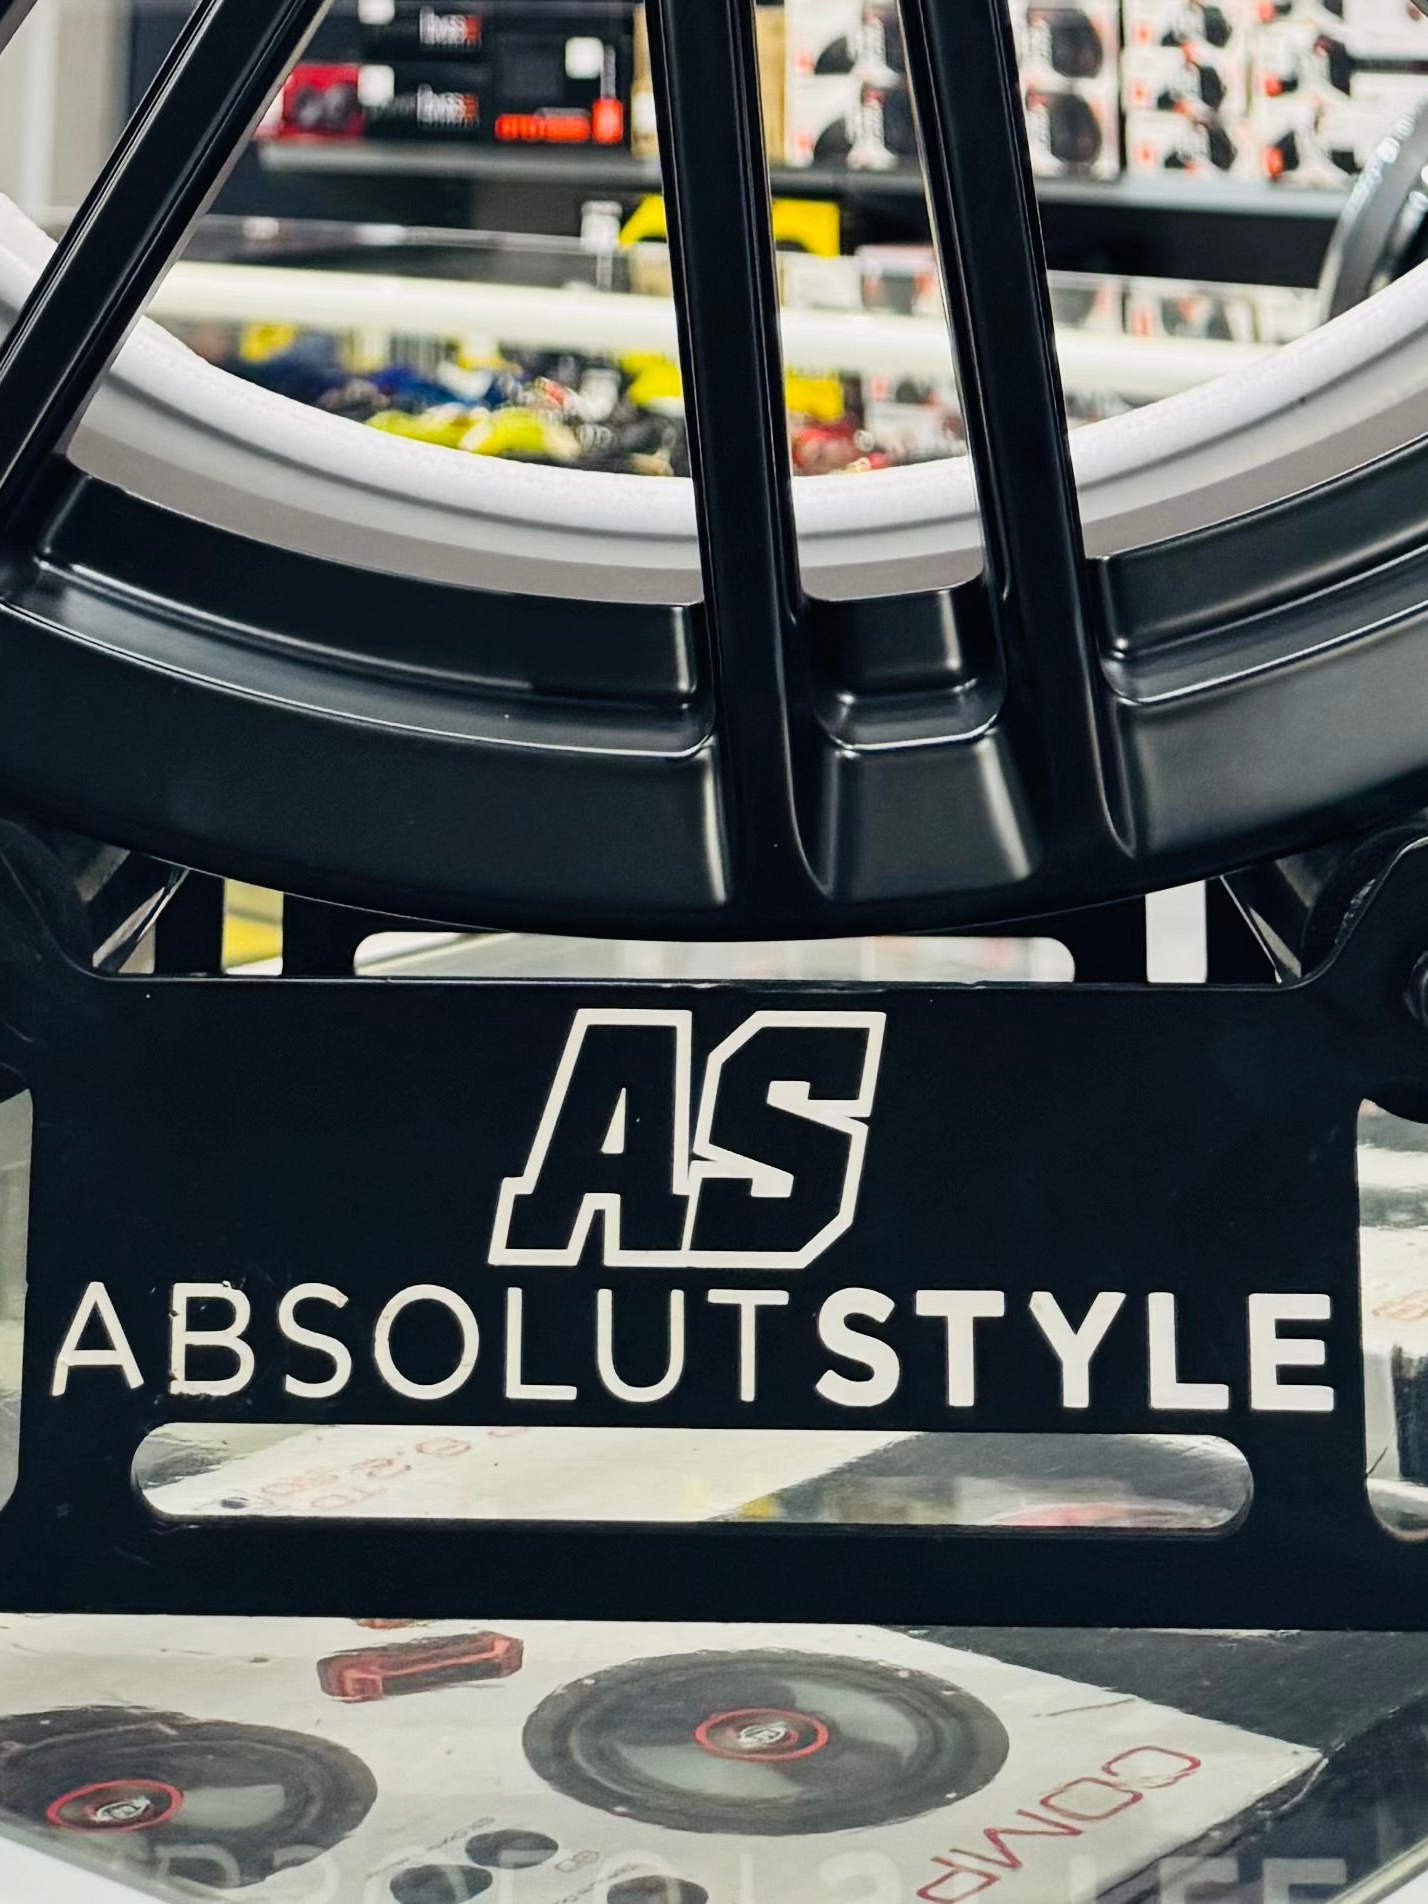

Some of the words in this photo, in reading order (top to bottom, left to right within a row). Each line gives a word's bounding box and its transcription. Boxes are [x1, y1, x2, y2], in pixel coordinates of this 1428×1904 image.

[488, 1008, 886, 1268] AS
[49, 1279, 1335, 1412] ABSOLUTSTYLE
[916, 1746, 1202, 1904] COMP
